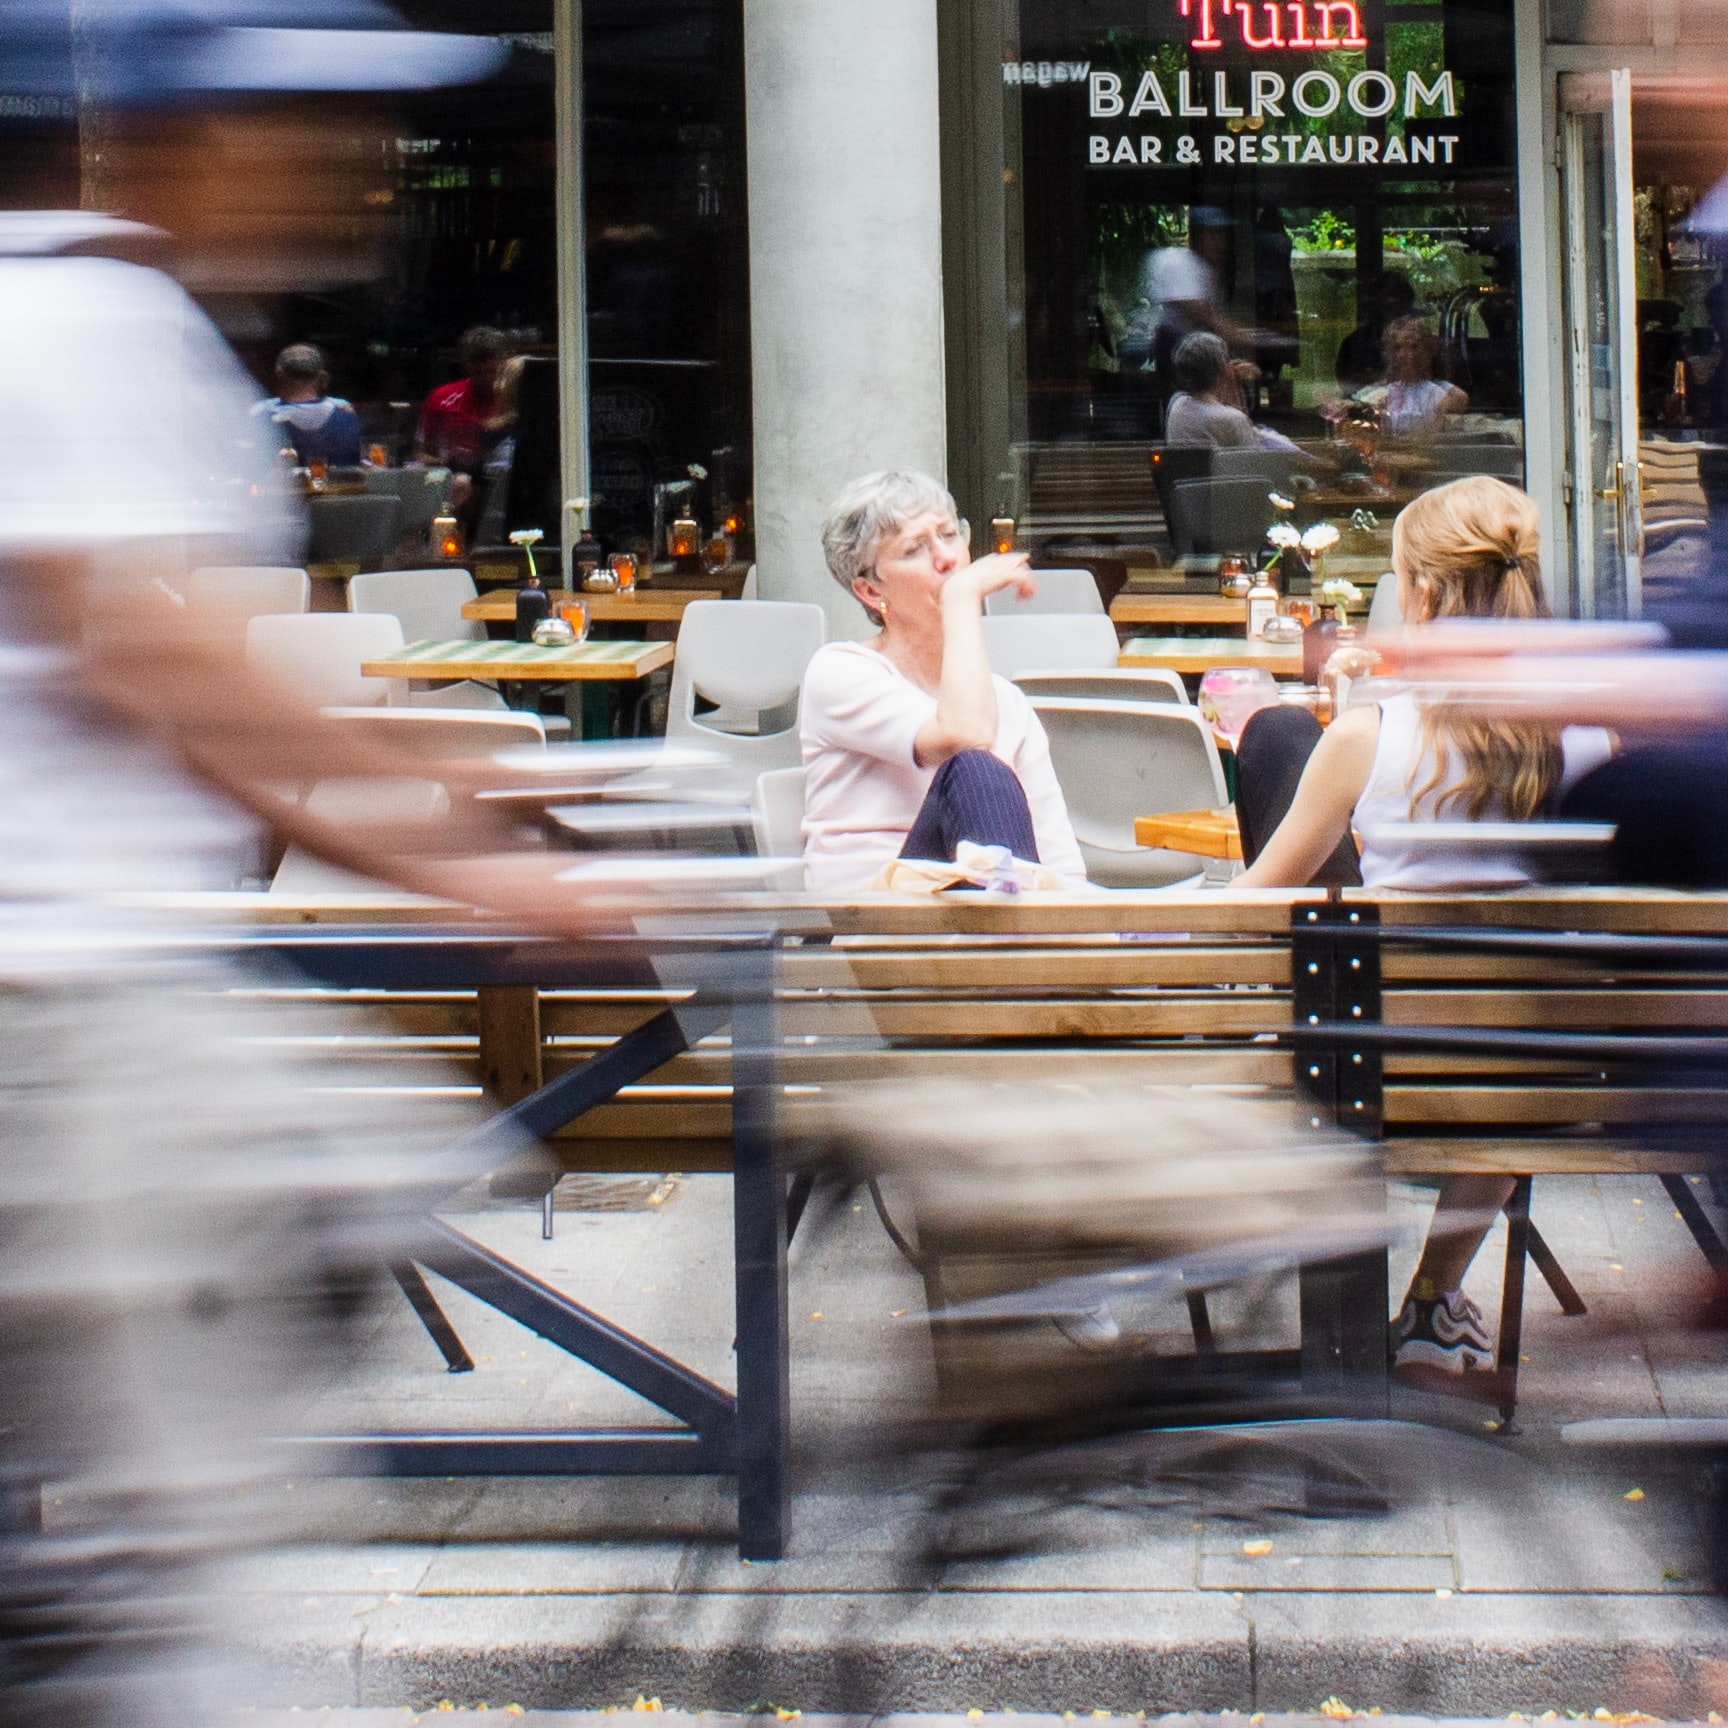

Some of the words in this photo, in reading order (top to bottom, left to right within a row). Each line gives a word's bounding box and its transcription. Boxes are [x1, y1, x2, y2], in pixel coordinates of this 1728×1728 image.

[1088, 70, 1456, 118] BALLROOM
[1088, 135, 1162, 164] BAR
[1176, 135, 1201, 164] &
[1214, 135, 1460, 164] RESTAURANT
